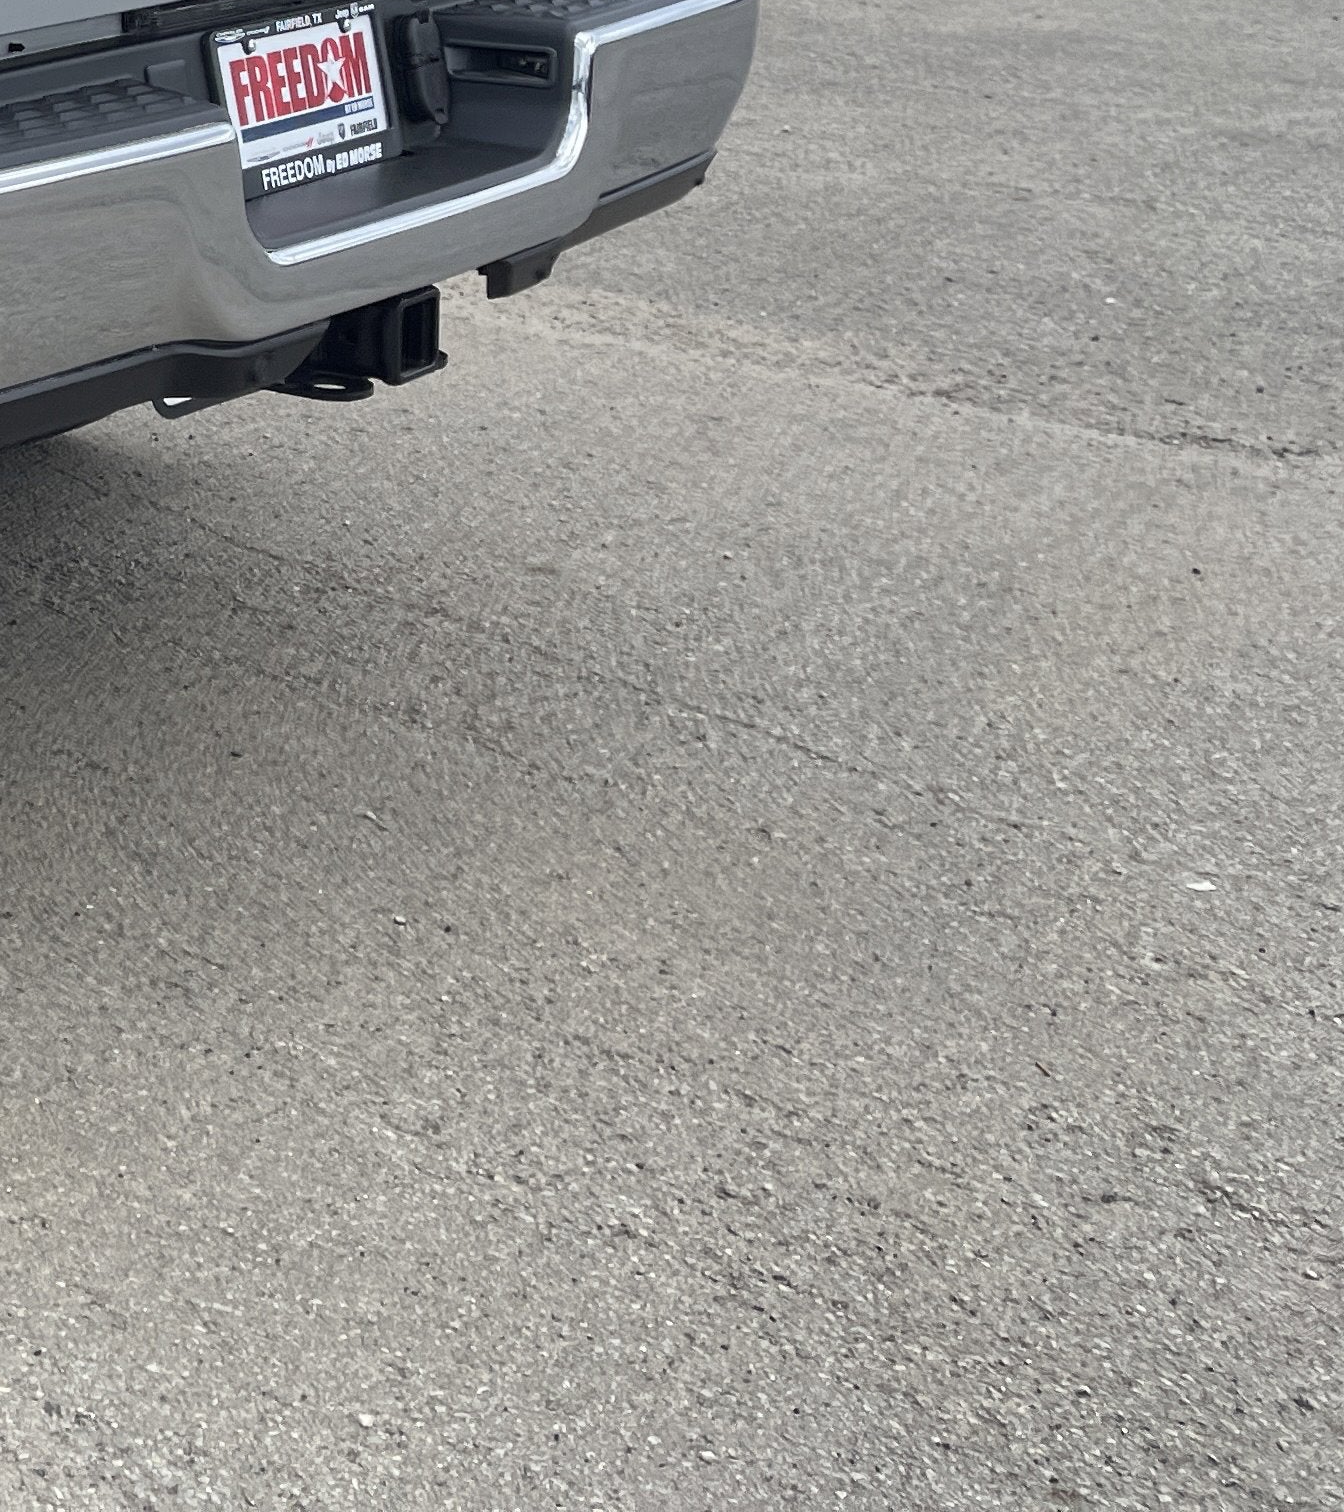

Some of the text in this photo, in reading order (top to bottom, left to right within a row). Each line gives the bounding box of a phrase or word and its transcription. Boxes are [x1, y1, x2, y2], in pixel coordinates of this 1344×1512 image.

[229, 32, 372, 126] FREEDOM
[261, 154, 325, 190] FREEDOM
[336, 151, 349, 169] ED
[349, 142, 383, 166] MORSE
